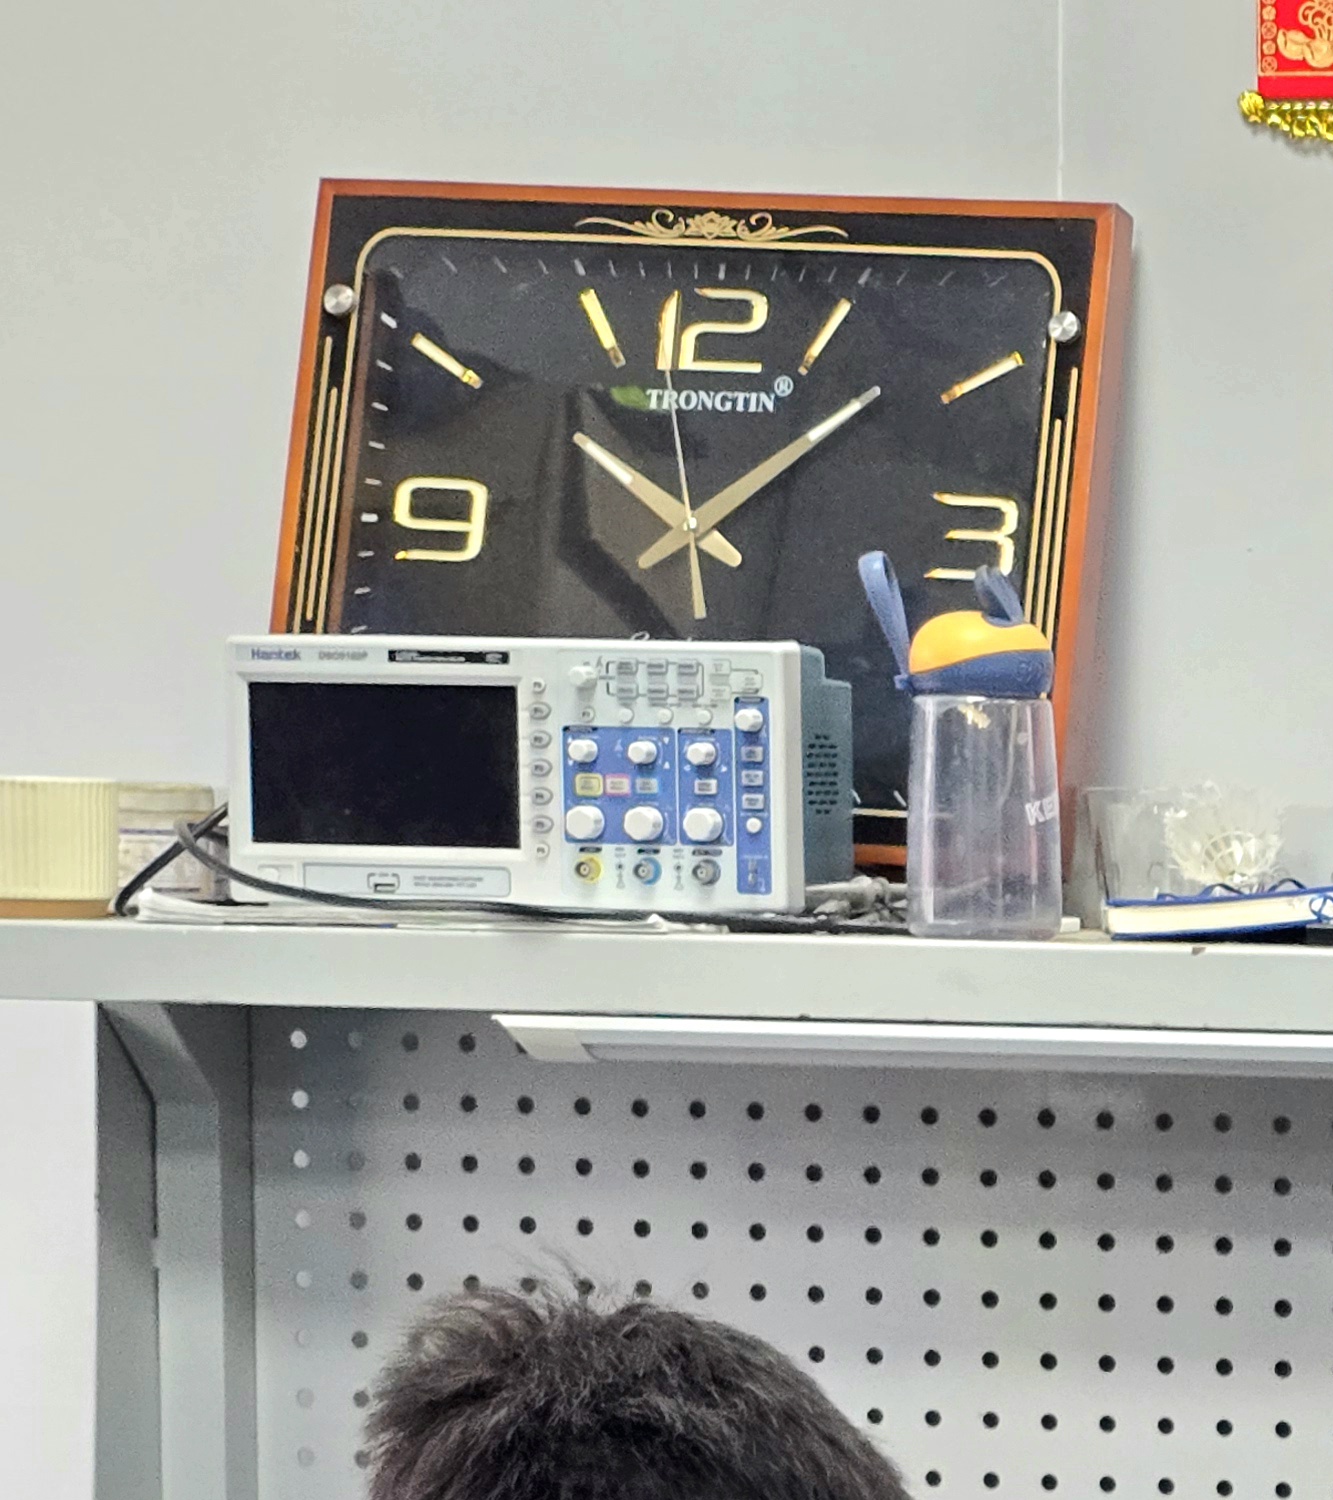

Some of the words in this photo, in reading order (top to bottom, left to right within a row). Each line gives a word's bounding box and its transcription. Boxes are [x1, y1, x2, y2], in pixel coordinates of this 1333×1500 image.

[656, 286, 770, 375] 12
[646, 388, 777, 413] TRONGTIN
[393, 477, 490, 563] 9
[923, 491, 1019, 581] 3
